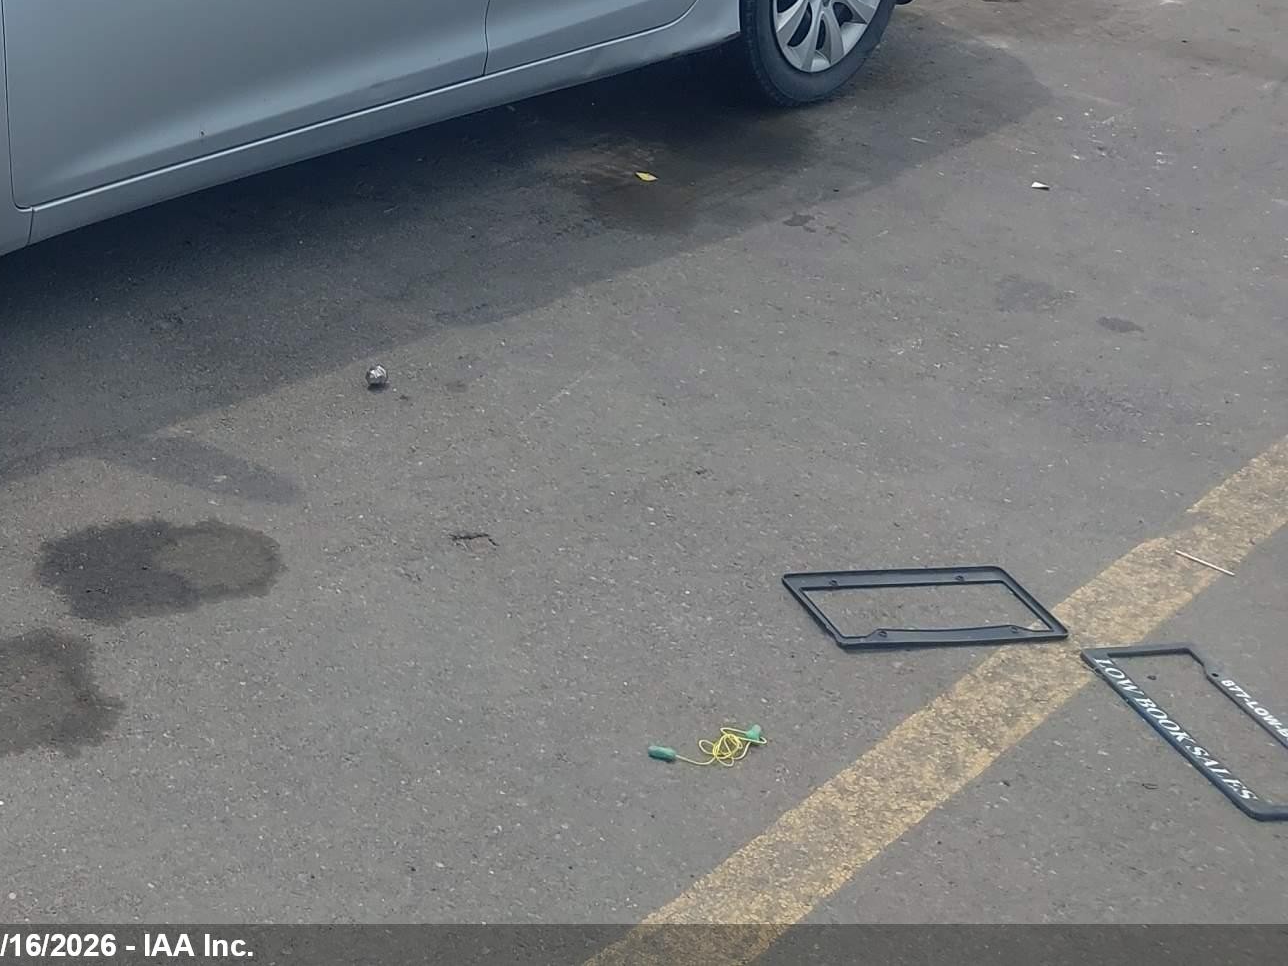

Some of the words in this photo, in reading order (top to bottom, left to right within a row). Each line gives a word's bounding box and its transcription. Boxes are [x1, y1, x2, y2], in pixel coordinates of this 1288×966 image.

[1094, 658, 1144, 697] LOW
[1133, 697, 1196, 744] BOOK
[1186, 745, 1258, 800] SALES
